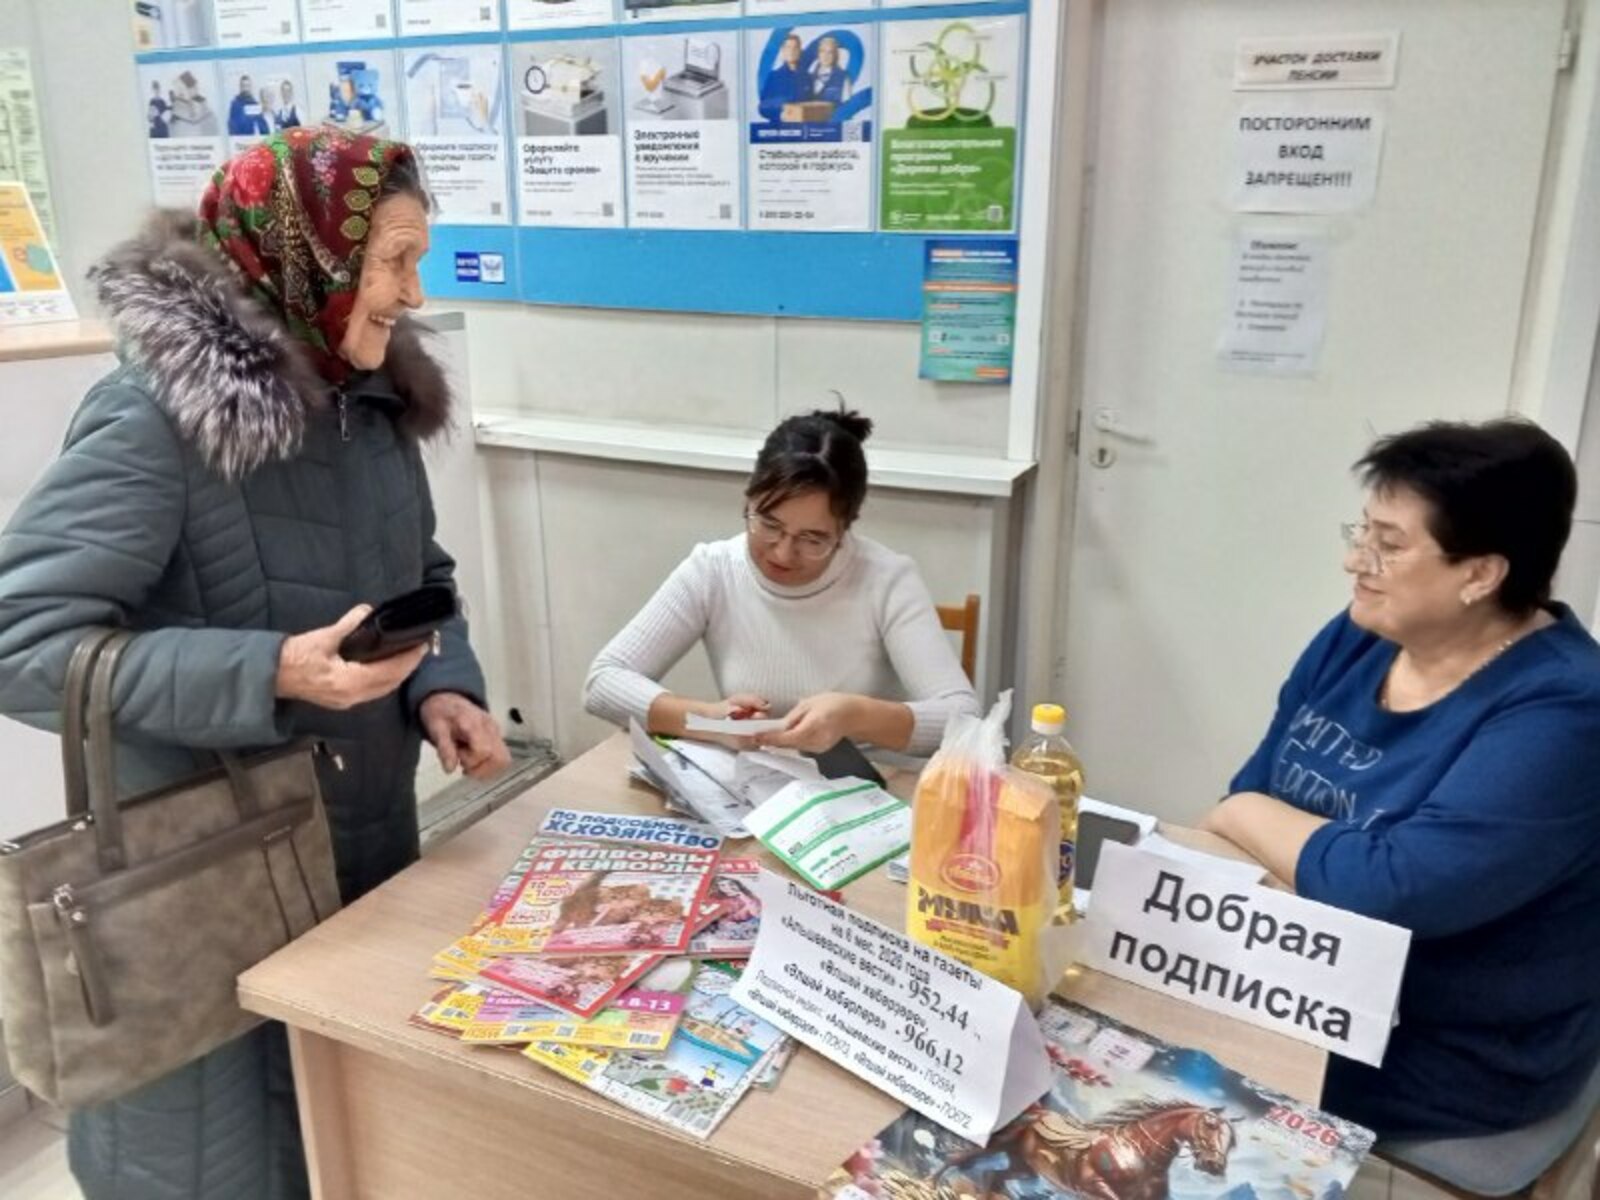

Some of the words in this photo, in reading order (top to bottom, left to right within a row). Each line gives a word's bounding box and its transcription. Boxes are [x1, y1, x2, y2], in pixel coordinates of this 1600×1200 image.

[1311, 50, 1381, 64] ДОСТАВКИ
[1239, 117, 1371, 132] ПОСТОРОННИМ
[1278, 145, 1324, 160] ВХОД
[1245, 171, 1352, 188] ЗАПРЕЩЕН!!!
[542, 848, 713, 864] ФИЛВОРДЫ
[789, 883, 844, 919] Льготная
[848, 914, 909, 952] подписка
[912, 946, 930, 964] на
[933, 956, 982, 989] газеты
[1143, 870, 1342, 966] Добрая
[829, 922, 844, 938] на
[855, 935, 877, 955] мес.
[879, 945, 903, 968] 2026
[905, 962, 930, 984] года
[907, 979, 970, 1029] 952,44
[1110, 930, 1352, 1042] подписка
[902, 1023, 965, 1075] 966,12
[1269, 1106, 1342, 1147] 2026
